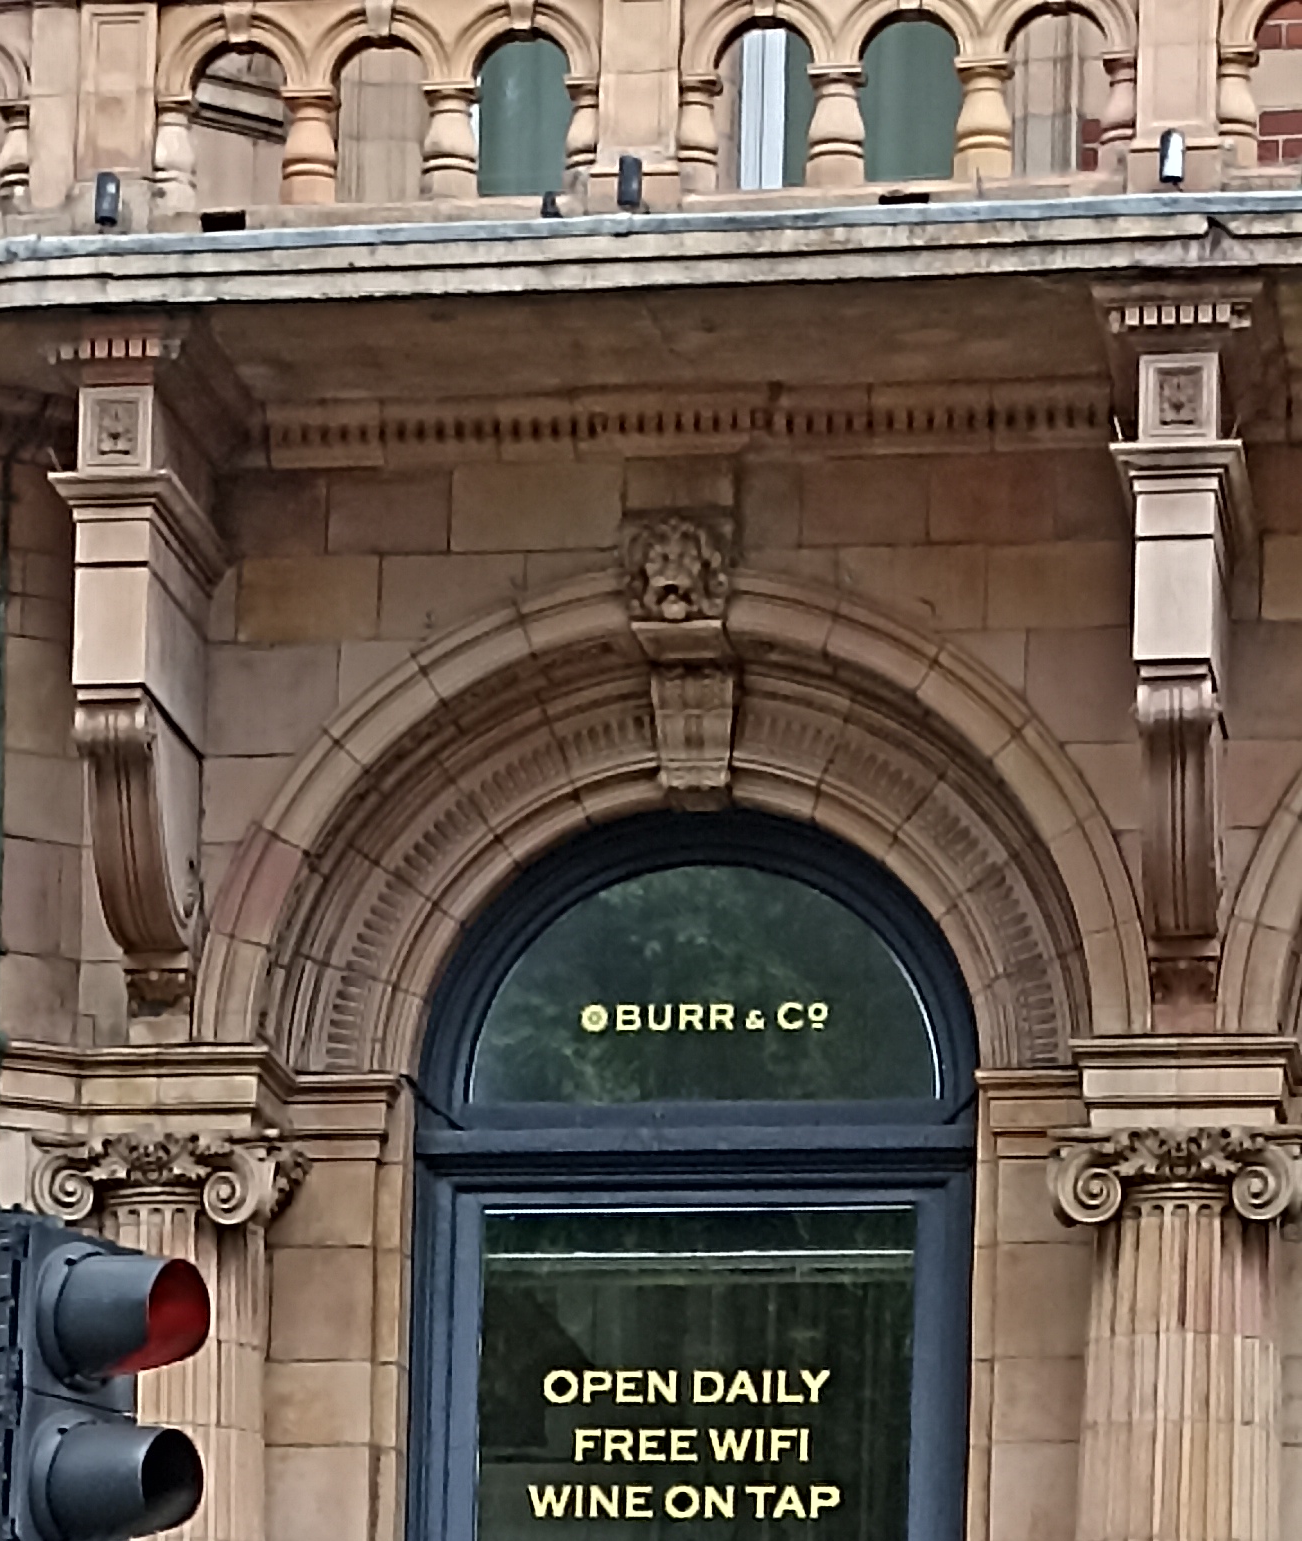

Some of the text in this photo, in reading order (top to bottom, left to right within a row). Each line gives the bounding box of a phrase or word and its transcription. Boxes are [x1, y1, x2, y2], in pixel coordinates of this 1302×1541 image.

[615, 1003, 735, 1031] BURR
[745, 1009, 765, 1031] &
[543, 1369, 831, 1404] OPEN DAILY
[574, 1428, 810, 1462] FREE WIFI
[528, 1484, 840, 1519] WINE ON TAP
